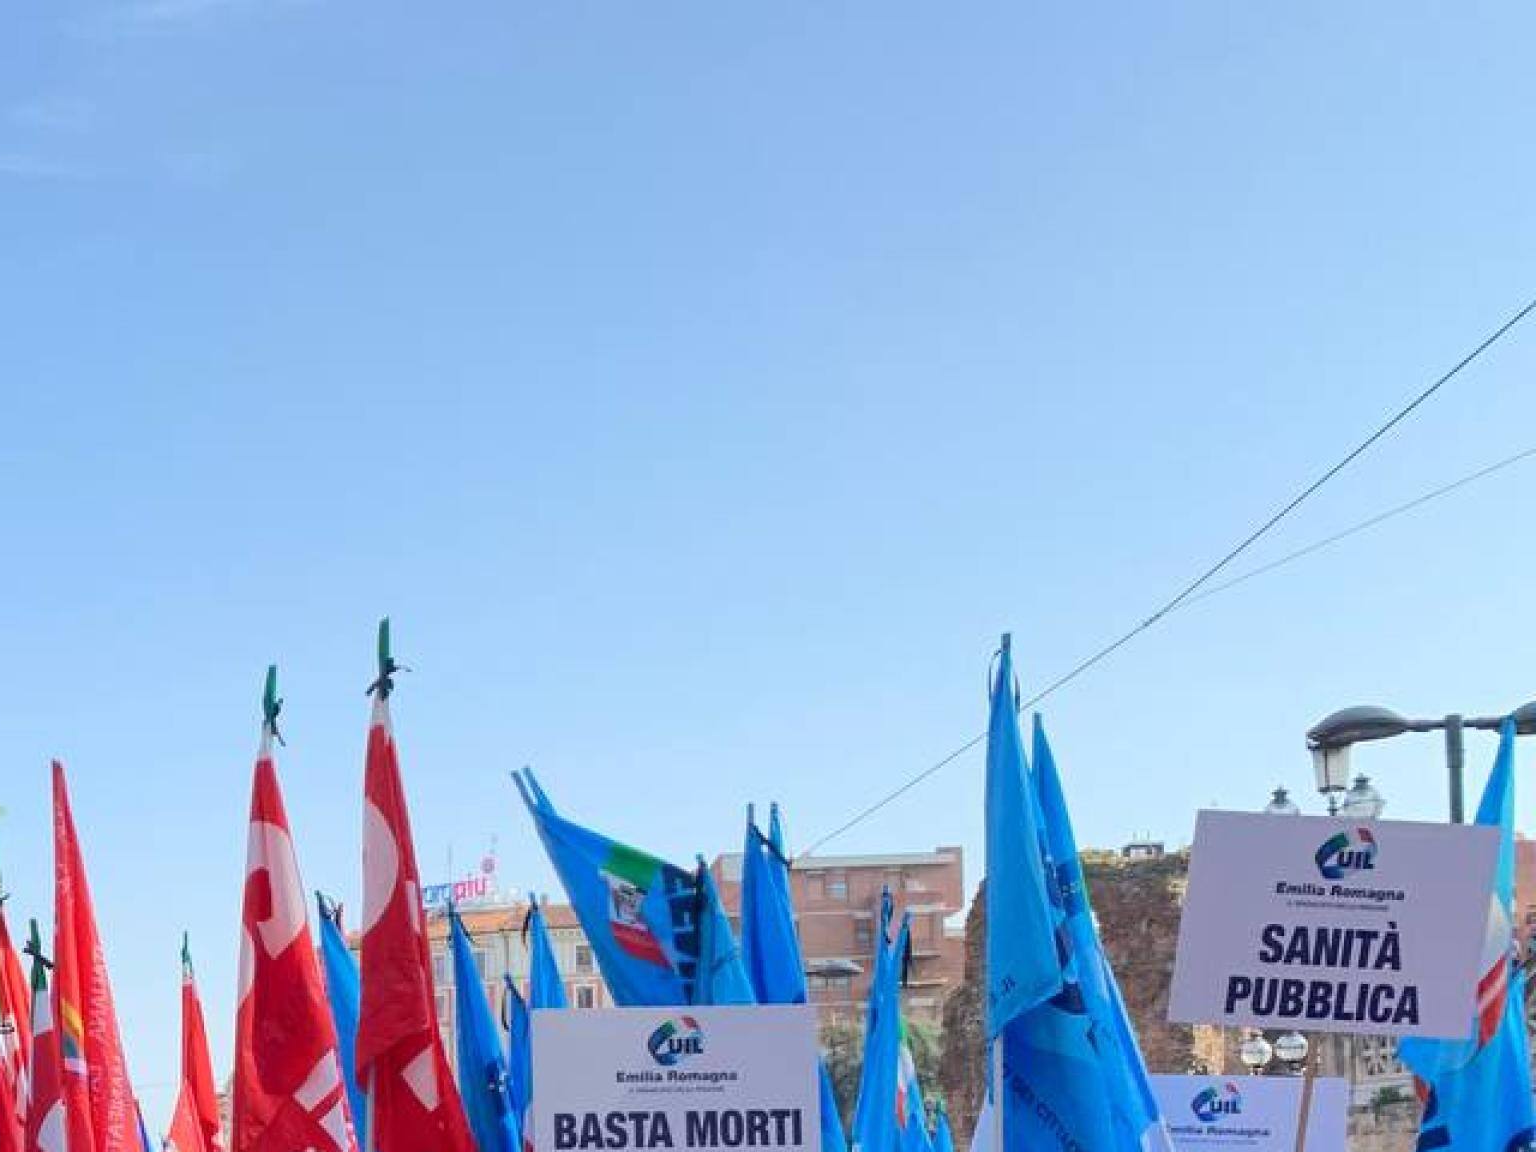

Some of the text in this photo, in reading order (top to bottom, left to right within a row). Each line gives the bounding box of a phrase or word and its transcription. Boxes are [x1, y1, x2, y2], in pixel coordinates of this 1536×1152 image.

[1276, 881, 1405, 903] Emilia Romagna
[1259, 921, 1402, 971] SANITÀ
[1224, 976, 1421, 1025] PUBBLICA
[616, 1070, 738, 1086] Emilia Romagna
[554, 1108, 803, 1150] BASTA MORTI
